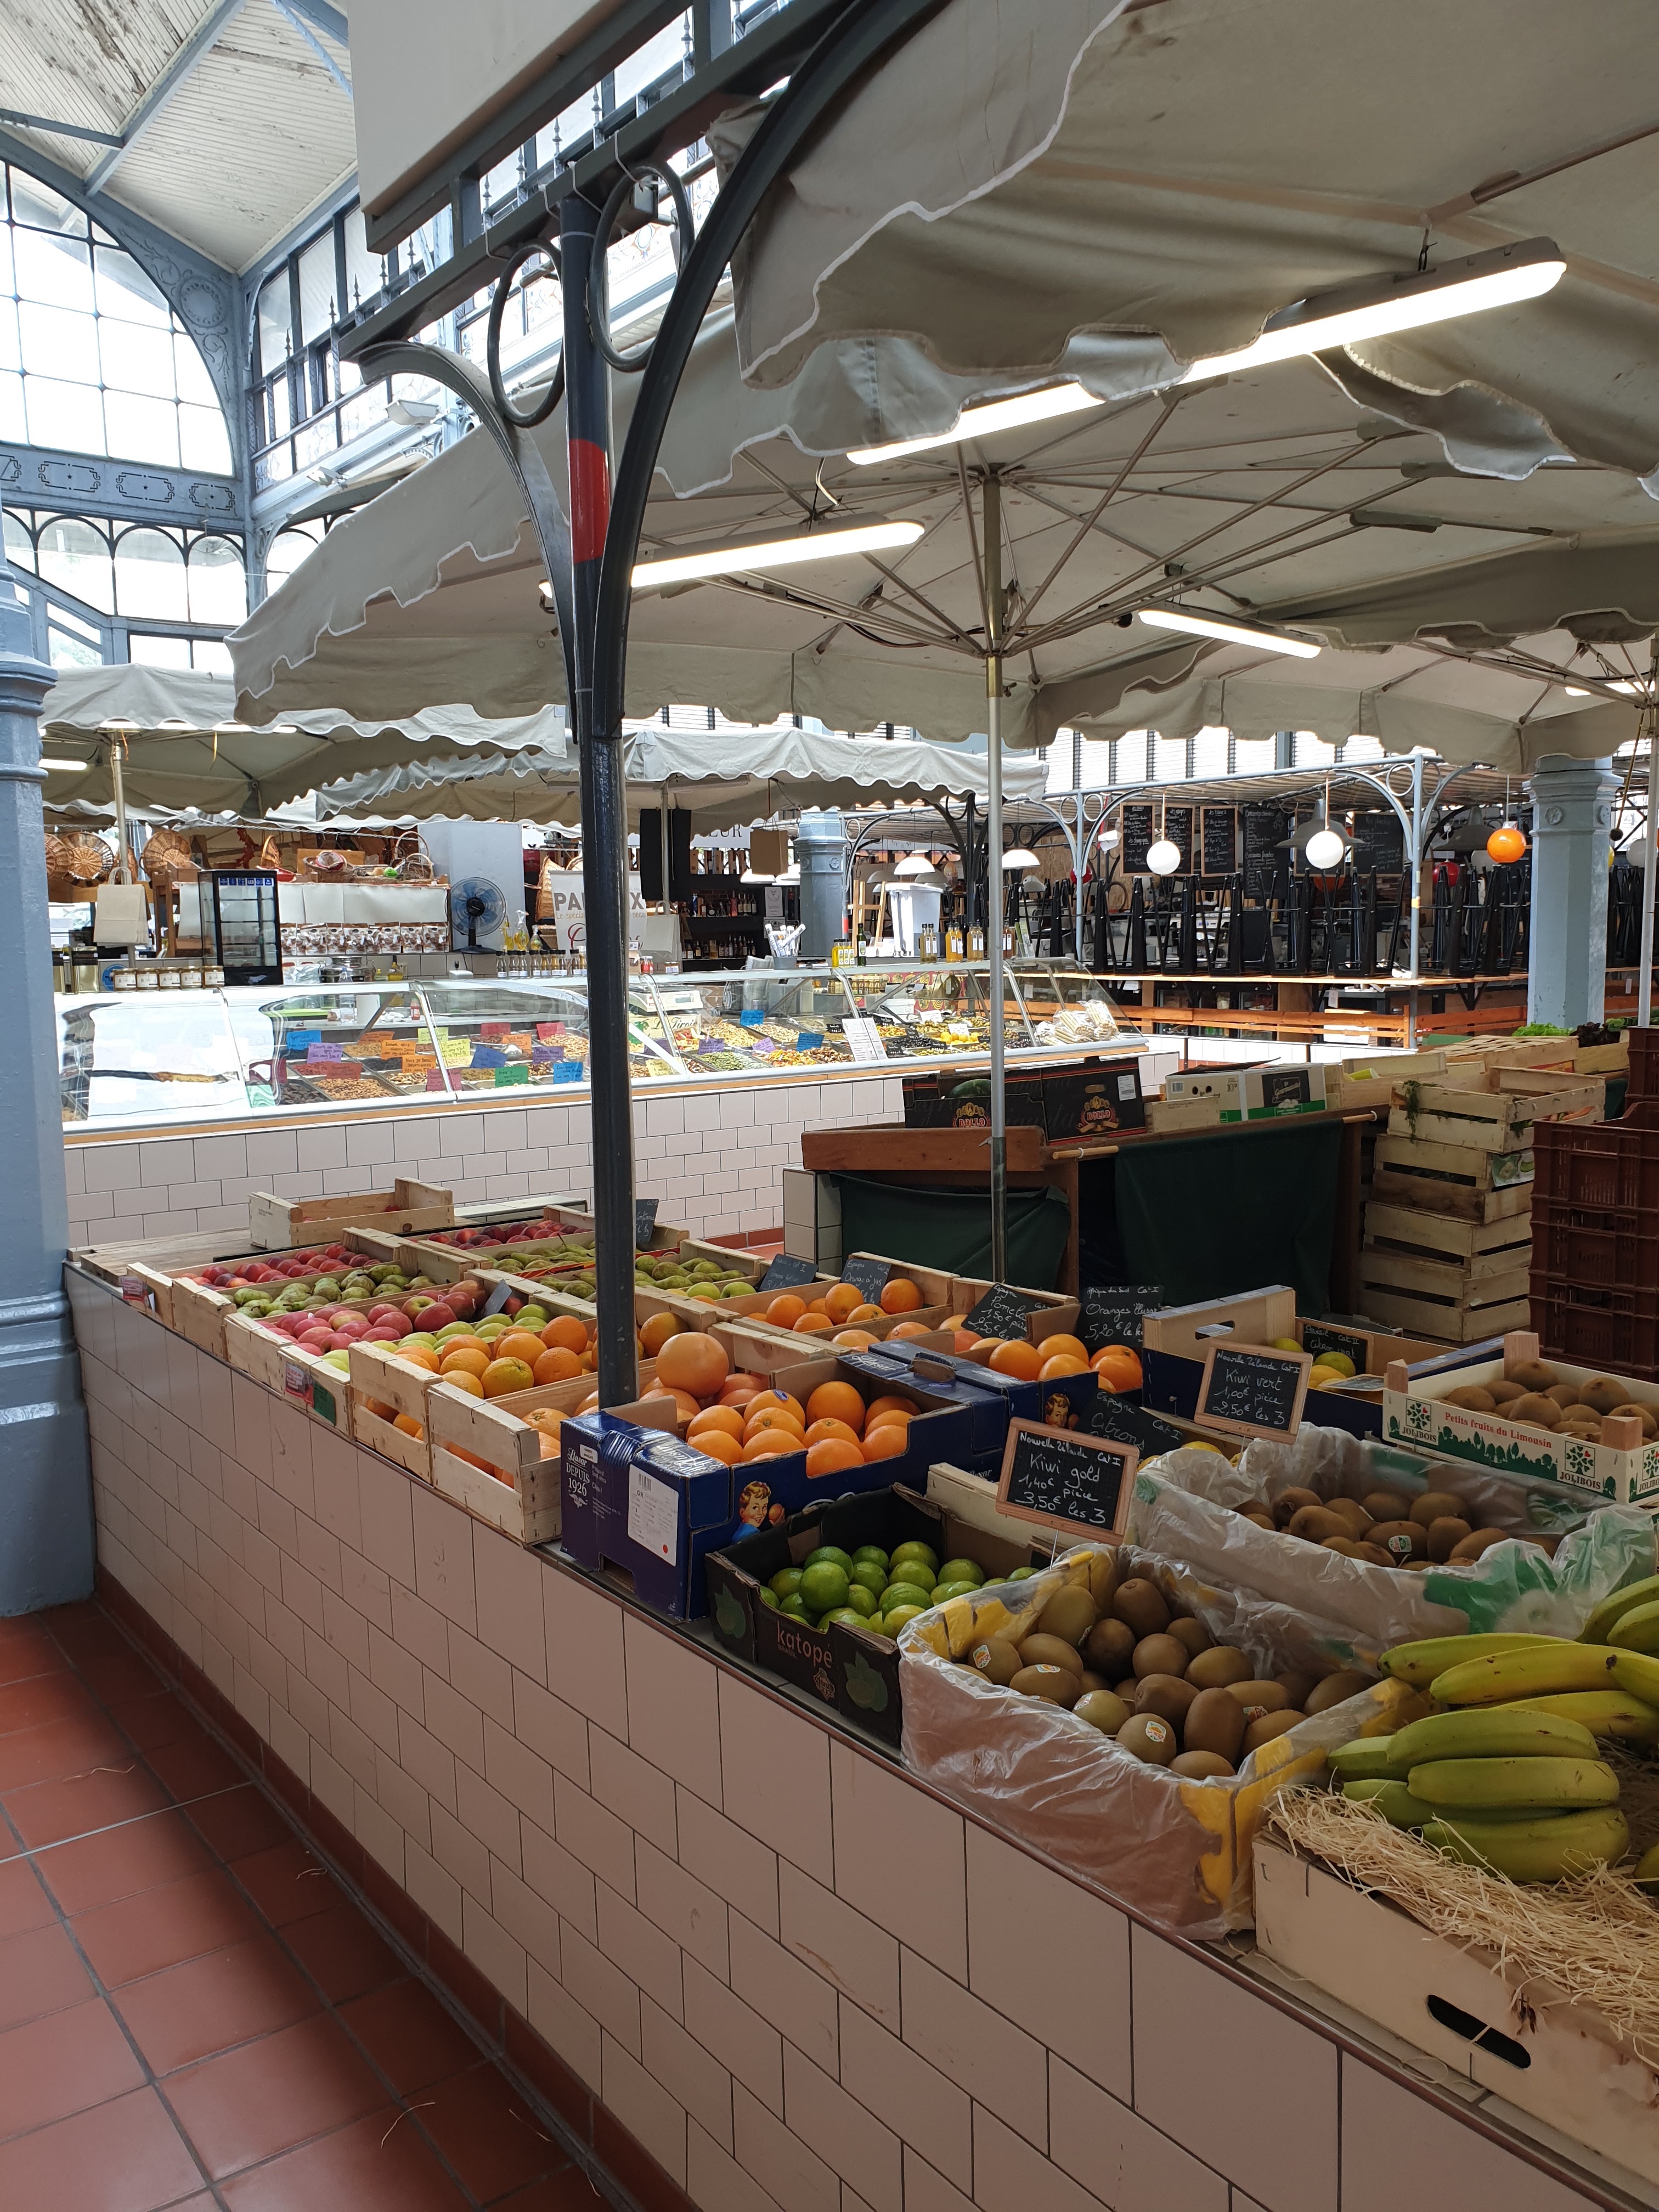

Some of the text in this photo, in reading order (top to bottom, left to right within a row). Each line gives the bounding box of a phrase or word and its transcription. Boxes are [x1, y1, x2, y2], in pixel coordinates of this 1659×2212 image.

[958, 1118, 985, 1127] BOLLO
[1087, 1109, 1110, 1121] BOLLO
[869, 1278, 882, 1290] jus
[1086, 1303, 1131, 1323] Oranges
[1123, 1322, 1132, 1336] le
[1217, 1351, 1245, 1364] Nouvelle
[1247, 1357, 1278, 1370] Zélande
[1226, 1369, 1282, 1391] Kiwi vert
[1097, 1391, 1135, 1413] Espagne
[1255, 1393, 1284, 1406] pièce
[1256, 1408, 1268, 1420] les
[1274, 1410, 1285, 1425] 3
[1402, 1426, 1437, 1443] JOLIBOIS
[1444, 1412, 1552, 1448] Petits fruits du Limousin
[1020, 1432, 1054, 1449] Nouvelle
[567, 1447, 588, 1467] Llusar
[566, 1463, 590, 1483] DEPUIS
[1030, 1453, 1101, 1489] Kiwi gold
[568, 1477, 587, 1496] 1926
[1560, 1472, 1600, 1489] JOLIBOIS
[1639, 1478, 1659, 1492] JOLIBO
[1063, 1488, 1098, 1502] pièce
[1068, 1501, 1086, 1518] les
[1089, 1508, 1105, 1523] 3
[777, 1620, 832, 1668] katopé
